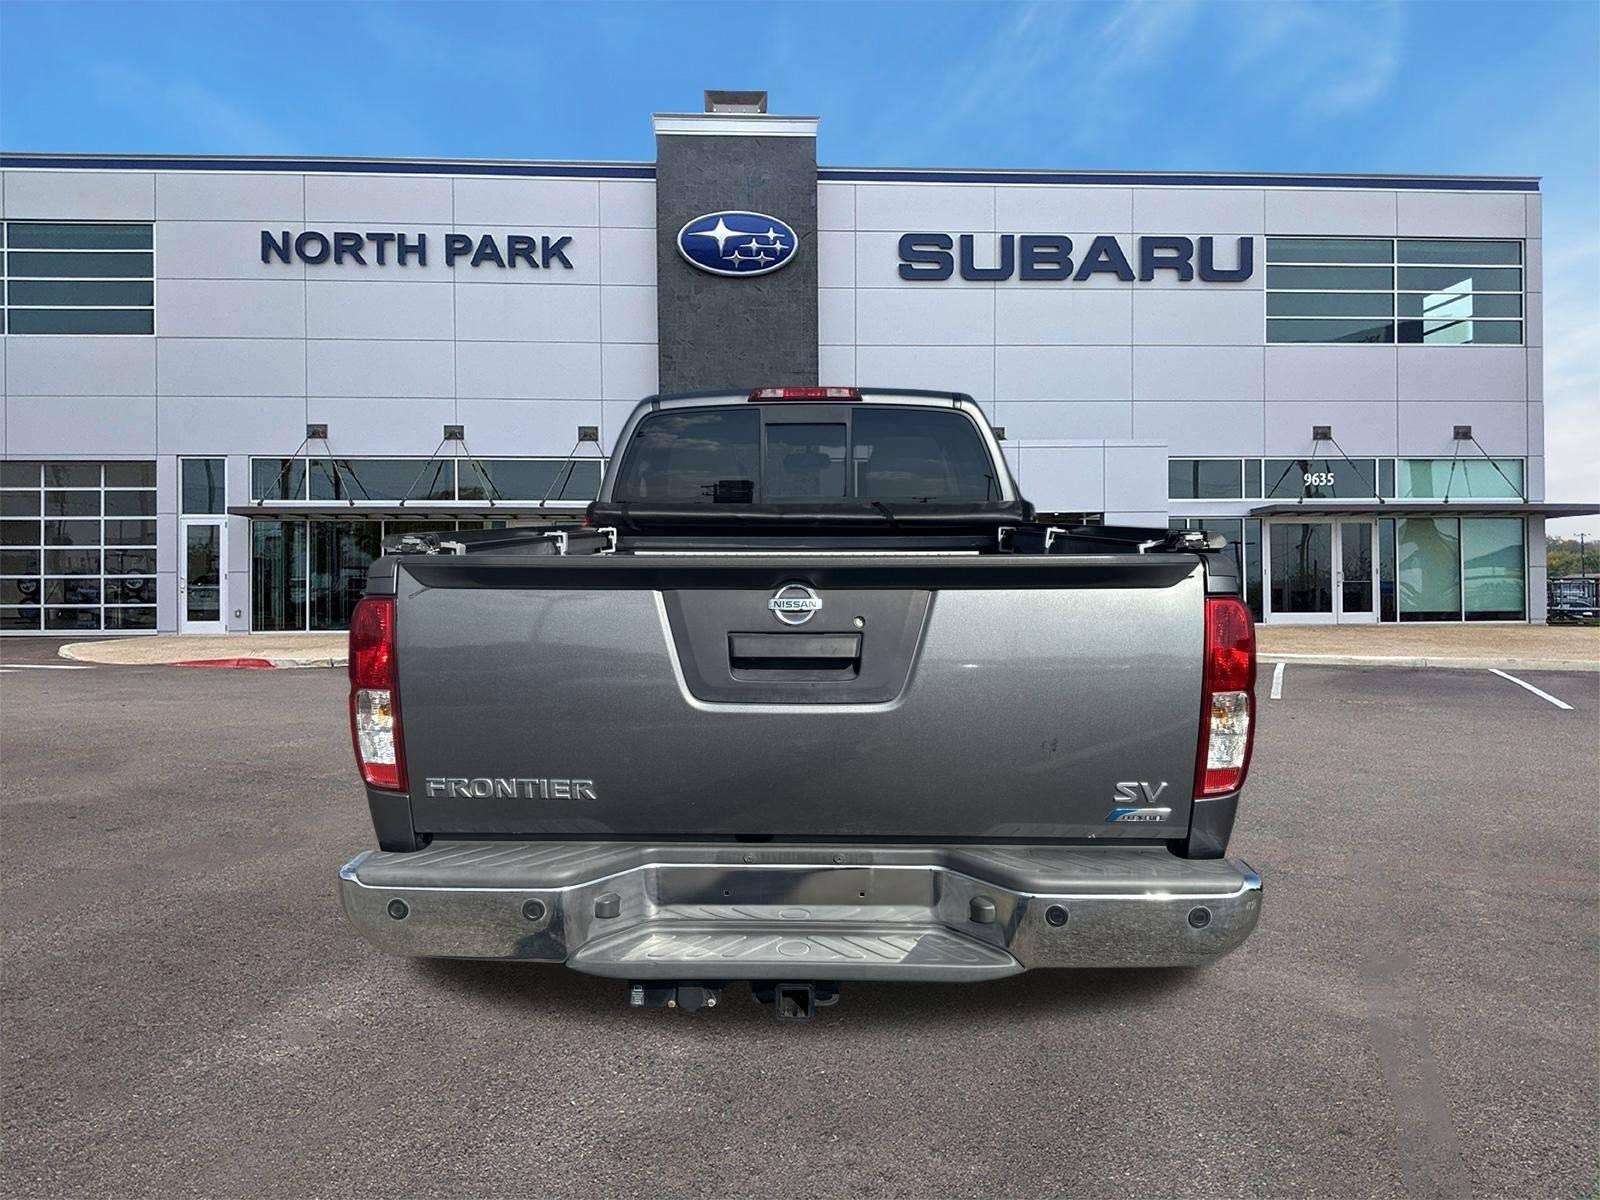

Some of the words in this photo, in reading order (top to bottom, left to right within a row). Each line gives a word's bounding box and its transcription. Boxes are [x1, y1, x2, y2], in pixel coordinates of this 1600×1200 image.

[260, 230, 427, 266] NORTH
[444, 233, 574, 269] PARK
[898, 233, 1254, 283] SUBARU
[1303, 472, 1335, 486] 9635
[773, 600, 817, 609] NISSAN
[425, 777, 598, 800] FRONTIER
[1113, 781, 1169, 803] SV
